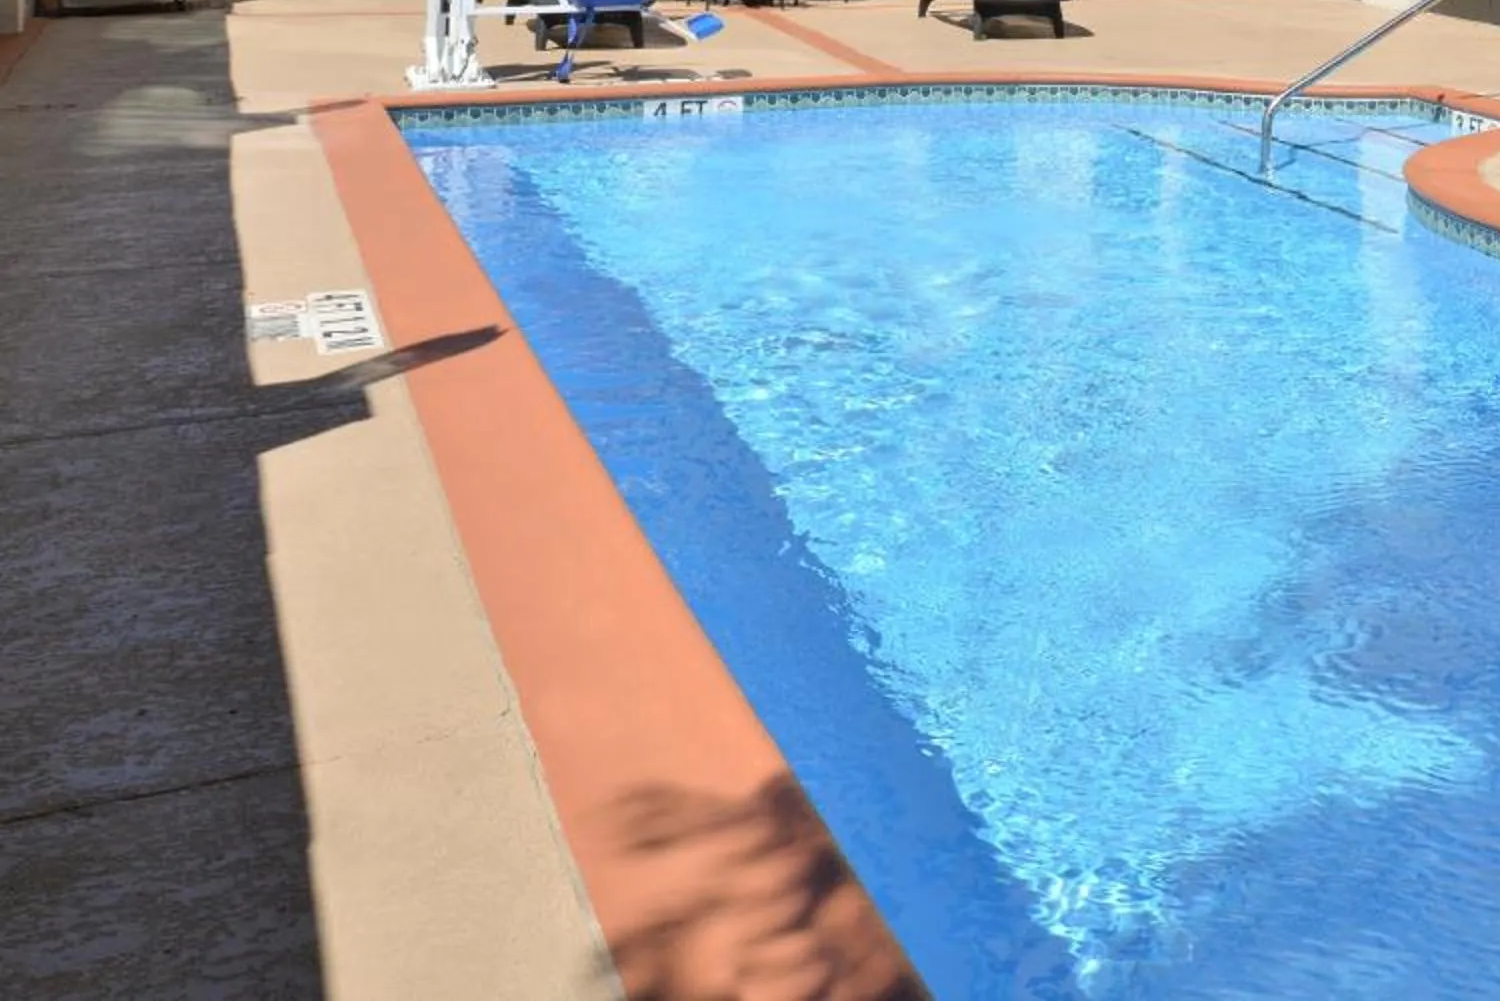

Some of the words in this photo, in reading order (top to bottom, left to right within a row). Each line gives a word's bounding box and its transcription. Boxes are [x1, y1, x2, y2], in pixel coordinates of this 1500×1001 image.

[654, 102, 666, 117] 4
[681, 100, 708, 116] FT
[1469, 116, 1483, 133] FT
